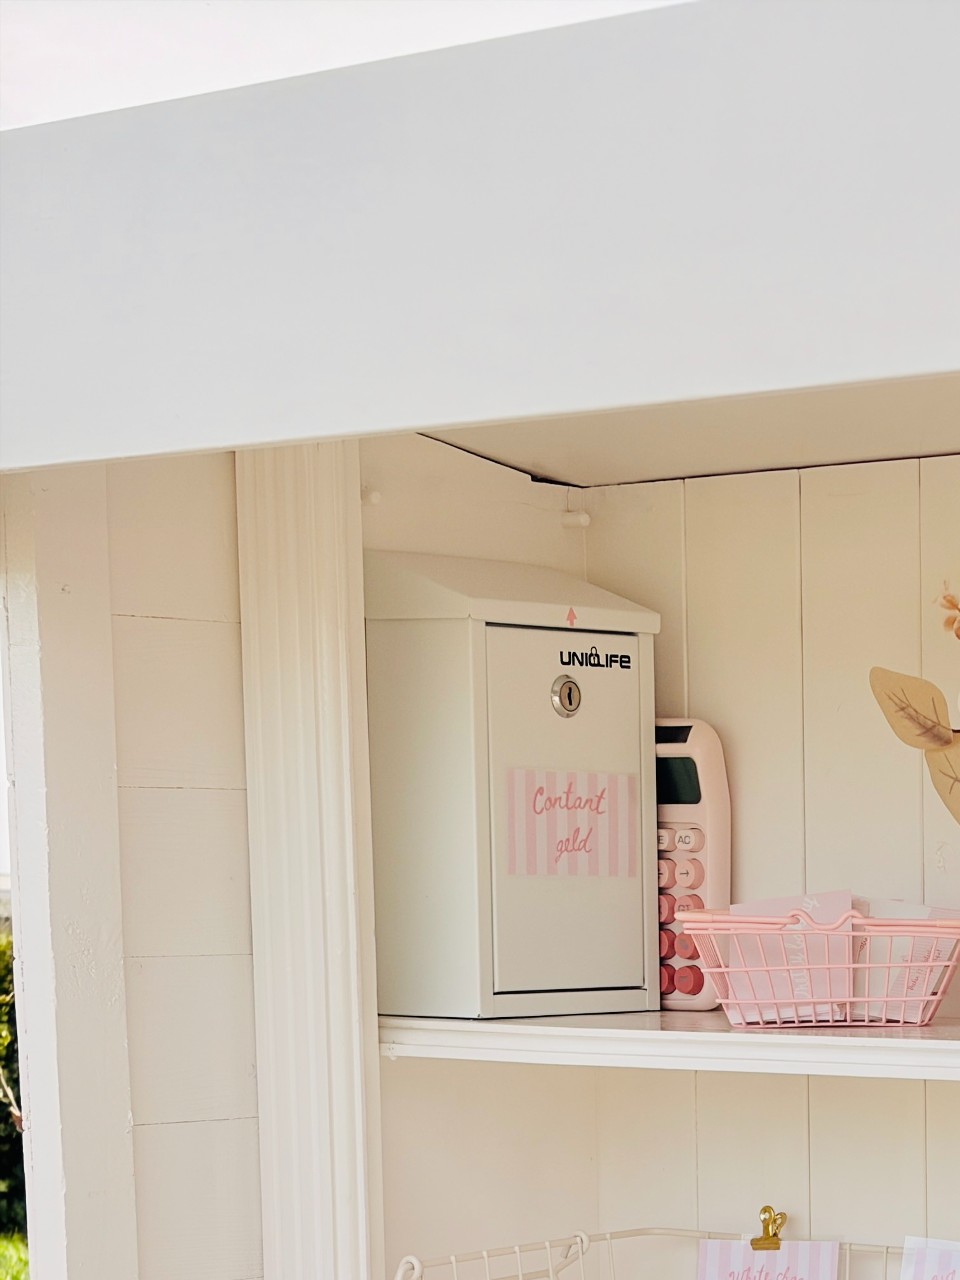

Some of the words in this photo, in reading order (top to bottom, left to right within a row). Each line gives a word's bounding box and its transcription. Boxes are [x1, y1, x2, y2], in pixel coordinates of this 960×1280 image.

[533, 782, 607, 816] Contant
[555, 827, 593, 863] geld
[677, 835, 691, 845] AC
